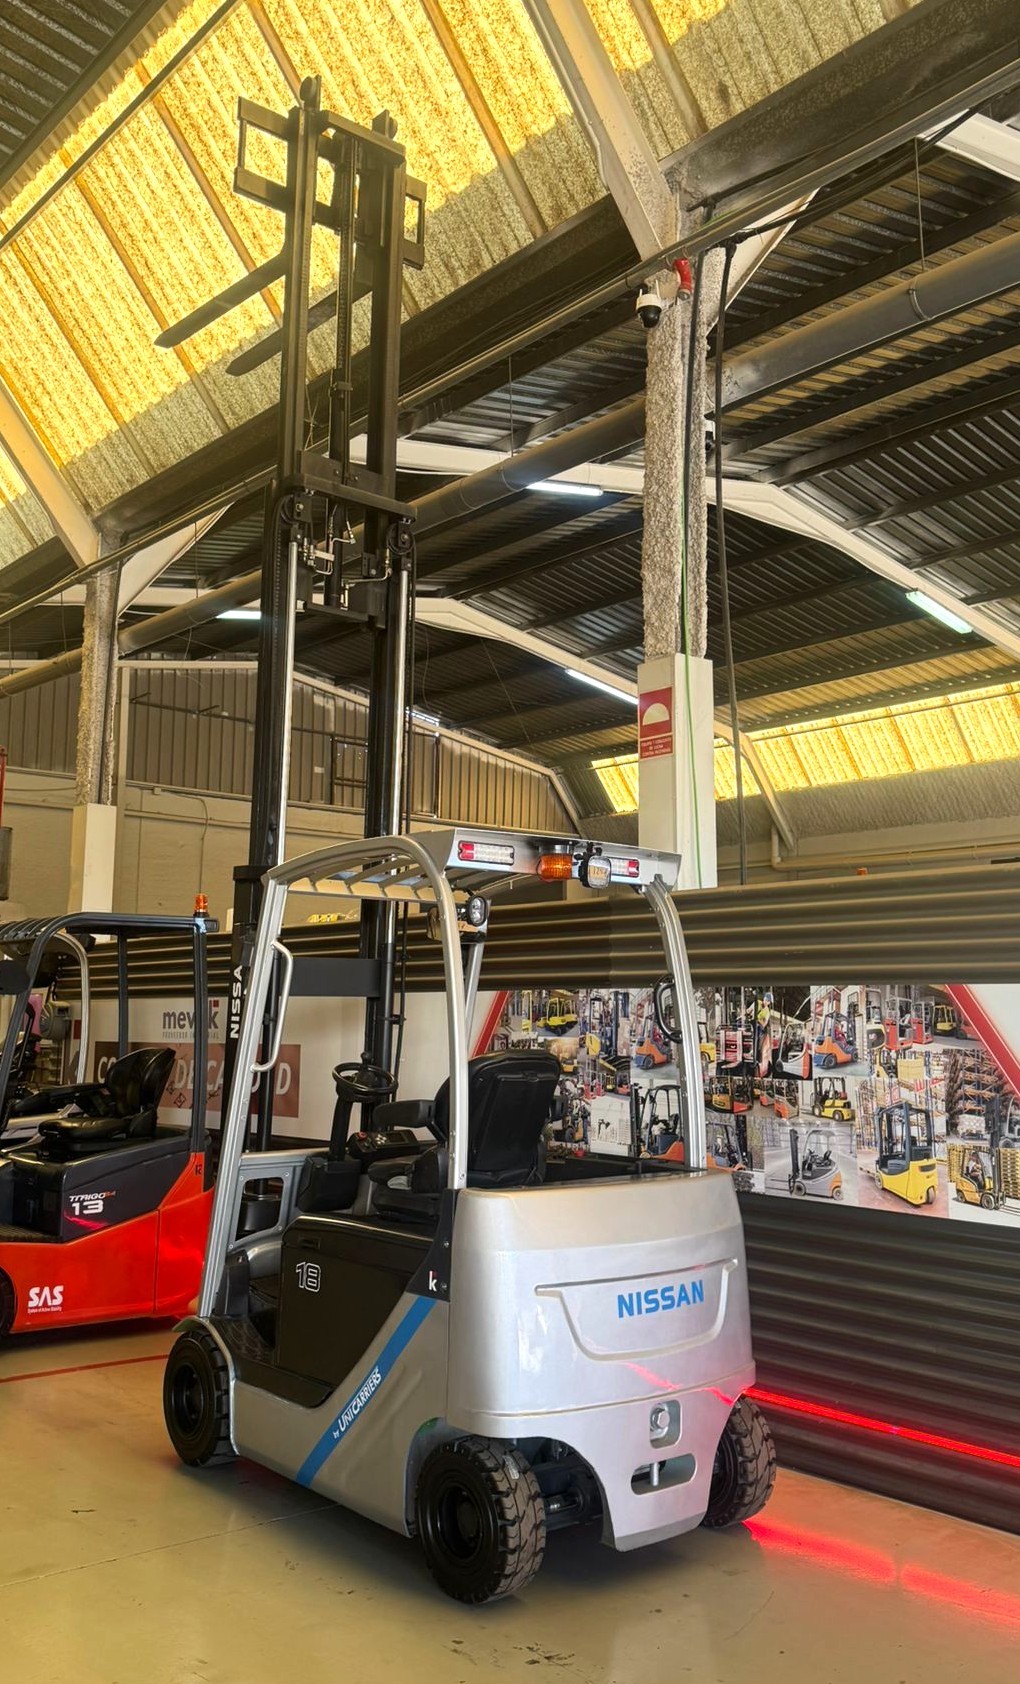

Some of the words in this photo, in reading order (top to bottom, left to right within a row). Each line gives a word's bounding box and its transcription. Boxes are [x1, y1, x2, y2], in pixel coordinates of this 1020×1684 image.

[162, 999, 219, 1030] mevk
[71, 1200, 104, 1216] 13
[295, 1261, 321, 1293] 18
[28, 1285, 64, 1307] SAS
[617, 1280, 704, 1318] NISSAN
